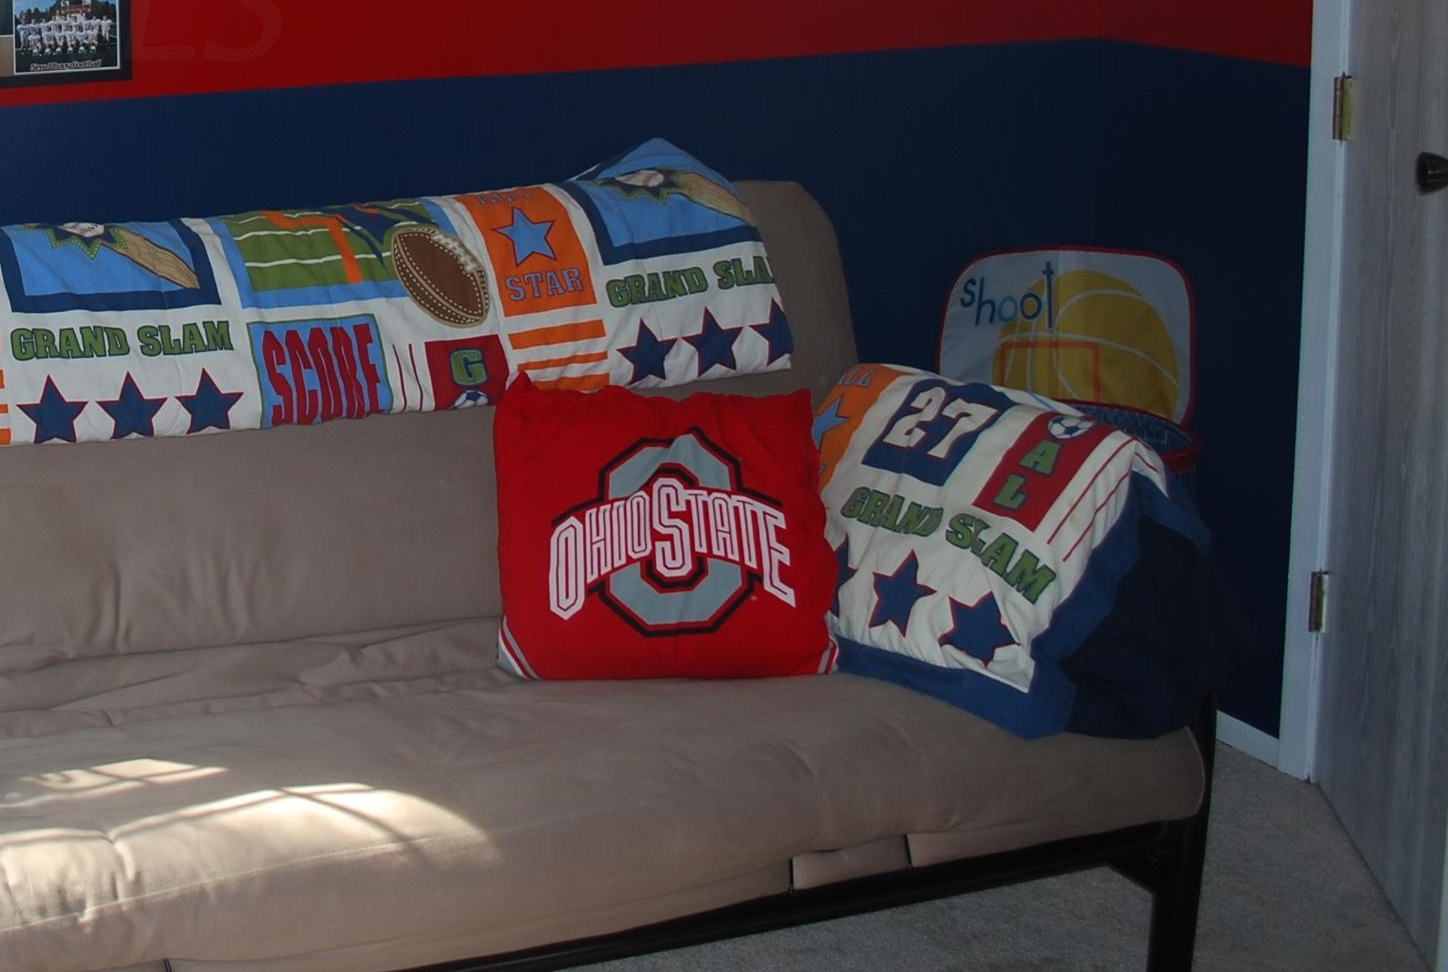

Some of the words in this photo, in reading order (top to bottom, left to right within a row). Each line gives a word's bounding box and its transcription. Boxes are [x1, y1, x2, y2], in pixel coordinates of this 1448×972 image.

[505, 267, 585, 301] STAR
[606, 266, 709, 308] GRAND
[10, 325, 130, 361] GRAND
[137, 321, 234, 358] SLAM
[262, 323, 385, 427] SCORE
[882, 386, 999, 459] 27
[548, 490, 653, 621] OHIO
[652, 477, 797, 608] STATE
[840, 486, 944, 538] GRAND
[945, 513, 1057, 605] SLAM
